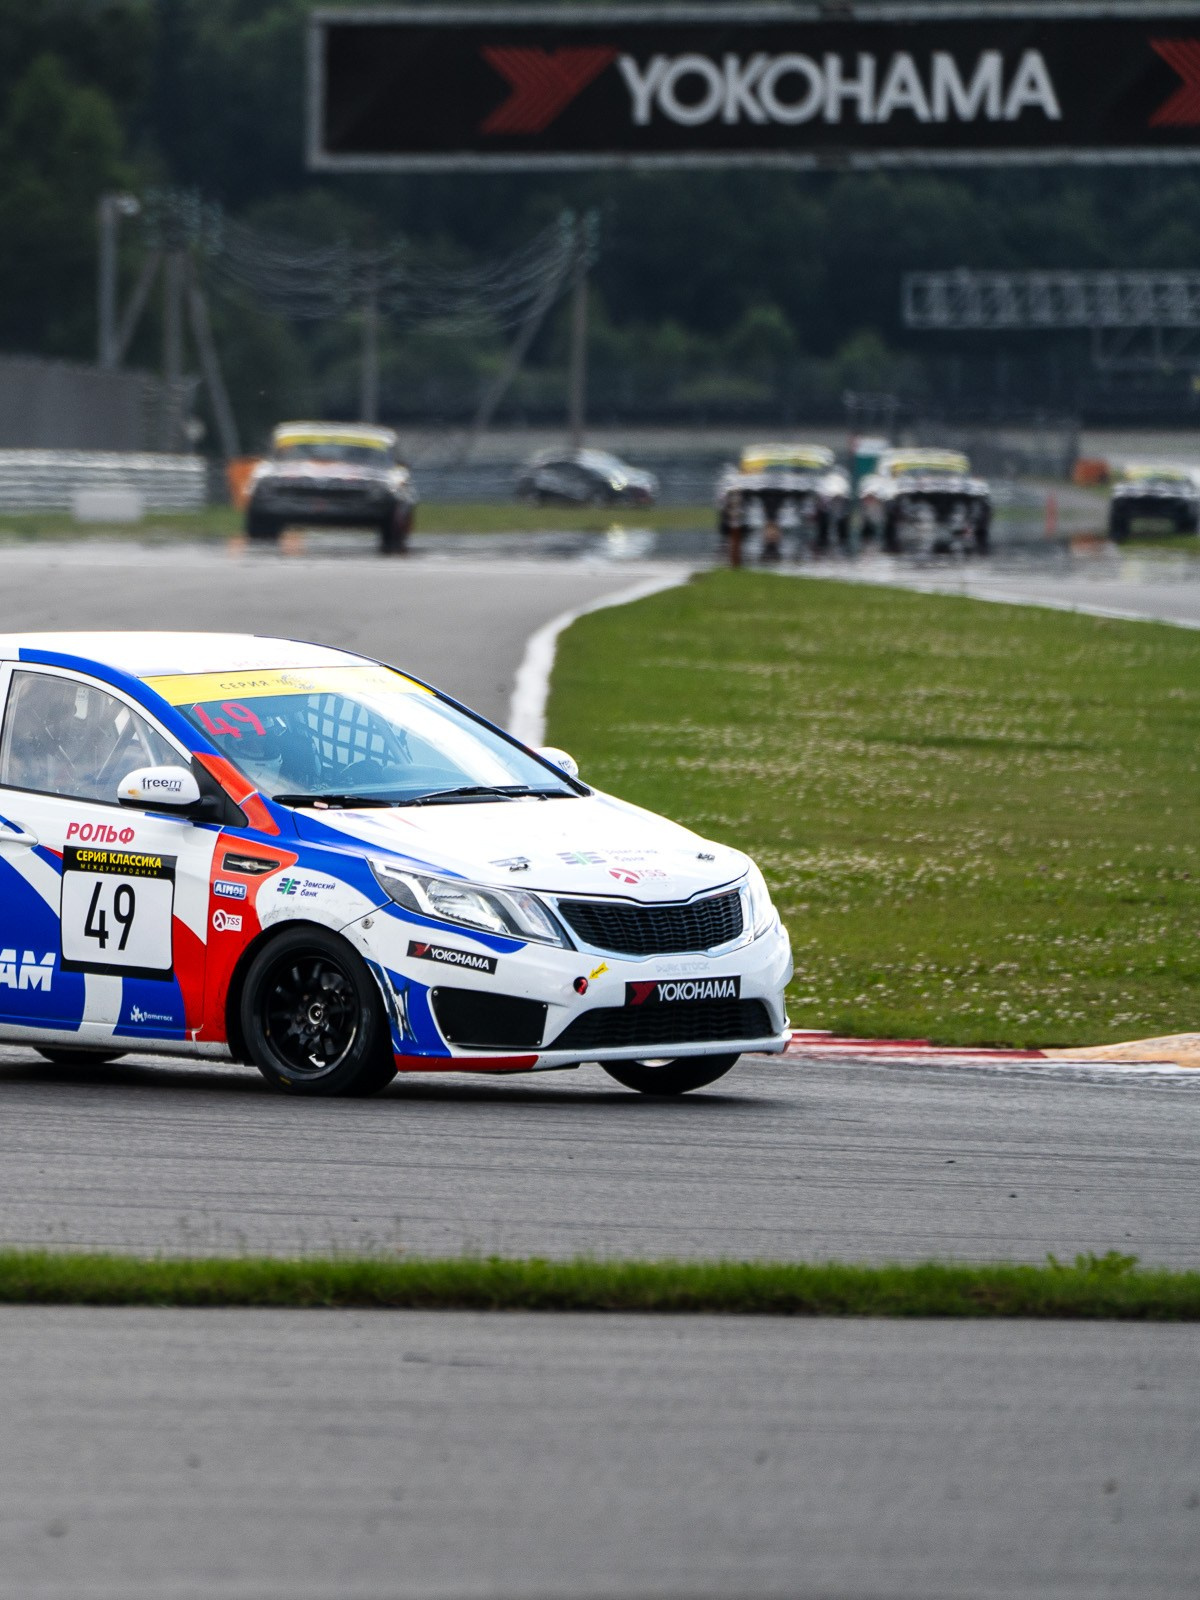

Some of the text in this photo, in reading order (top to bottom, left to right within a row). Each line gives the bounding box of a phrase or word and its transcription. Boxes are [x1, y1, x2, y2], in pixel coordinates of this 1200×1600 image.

[618, 49, 1062, 125] YOKOHAMA
[193, 701, 267, 739] 49
[141, 778, 182, 789] freem
[66, 822, 135, 844] РОЛЬФ
[76, 850, 162, 868] СЕРИЯ КЛАССИКА
[80, 863, 158, 876] МЕЖДУНАРОДНАЯ
[214, 884, 245, 896] AIMOL
[300, 889, 319, 898] банк
[302, 880, 336, 890] Земский
[84, 881, 136, 951] 49
[226, 916, 241, 926] TSS
[430, 948, 490, 970] YOKOHAMA
[657, 980, 736, 1002] YOKOHAMA
